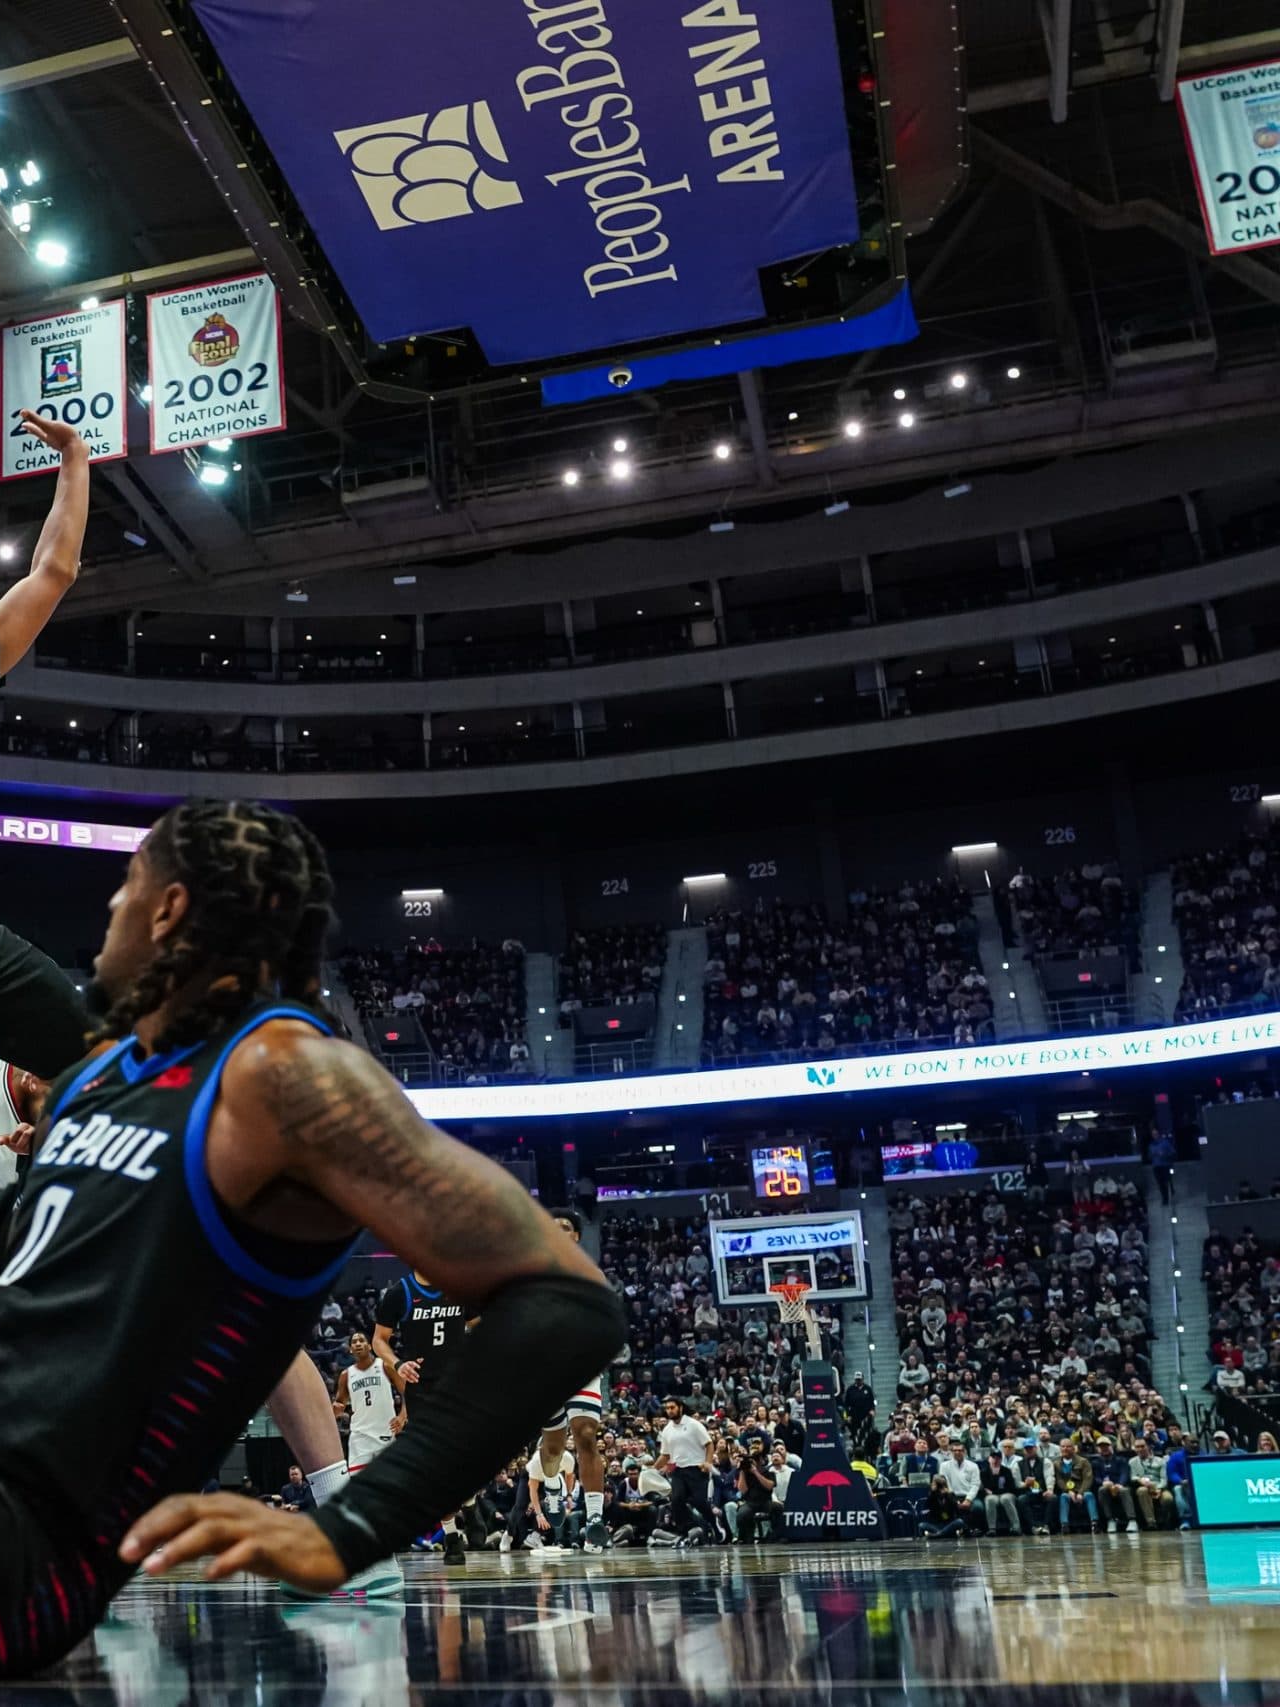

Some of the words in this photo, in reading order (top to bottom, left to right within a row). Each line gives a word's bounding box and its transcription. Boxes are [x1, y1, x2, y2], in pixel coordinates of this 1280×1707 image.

[681, 0, 785, 183] ARENA
[1192, 73, 1245, 91] UConn
[1216, 165, 1280, 204] 20
[161, 289, 203, 307] UConn
[207, 277, 265, 297] Women's
[181, 294, 246, 317] Basketball
[12, 319, 52, 337] UConn
[56, 307, 111, 327] Women's
[31, 324, 92, 346] Basketball
[163, 362, 269, 409] 2002
[174, 398, 260, 425] NATIONAL
[168, 414, 268, 443] CHAMPIONS
[70, 825, 92, 844] B
[1045, 827, 1076, 845] 226
[748, 861, 777, 879] 225
[602, 879, 629, 897] 224
[404, 902, 432, 918] 223
[865, 1065, 896, 1079] WE
[974, 1052, 1030, 1069] MOVE
[1123, 1040, 1152, 1055] WE
[1165, 1031, 1219, 1050] MOVE
[765, 1168, 801, 1197] 26
[991, 1171, 1027, 1192] 122
[432, 1321, 445, 1346] 5
[364, 1390, 372, 1407] 2
[784, 1510, 878, 1527] TRAVELERS
